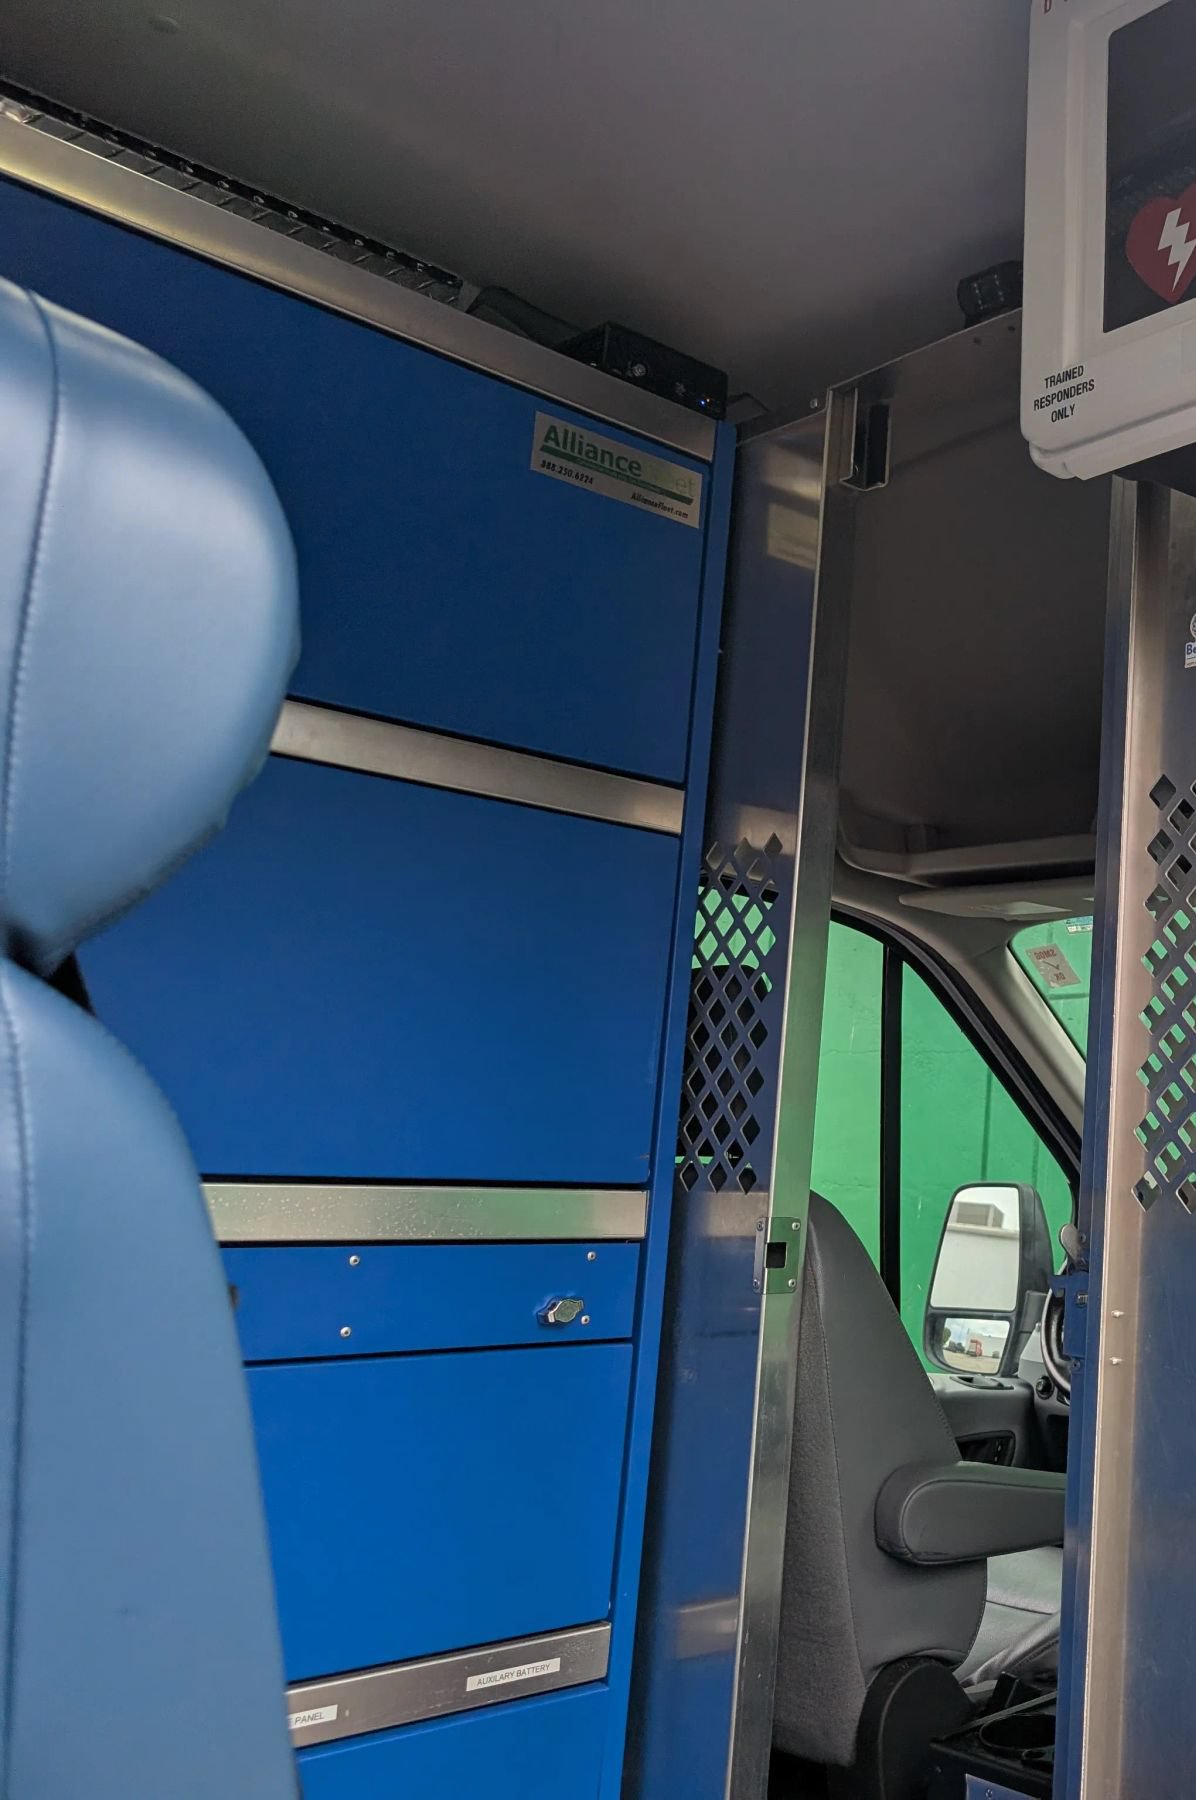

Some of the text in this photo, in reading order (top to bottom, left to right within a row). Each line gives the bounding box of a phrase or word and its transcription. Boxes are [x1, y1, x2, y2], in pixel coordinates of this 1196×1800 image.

[1044, 365, 1084, 389] TRAINED
[1033, 378, 1095, 411] RESPONDERS
[1051, 403, 1075, 423] ONLY
[543, 424, 642, 477] Alliance
[476, 1663, 551, 1687] AUXILARY BATTERY
[294, 1711, 325, 1726] PANEL
